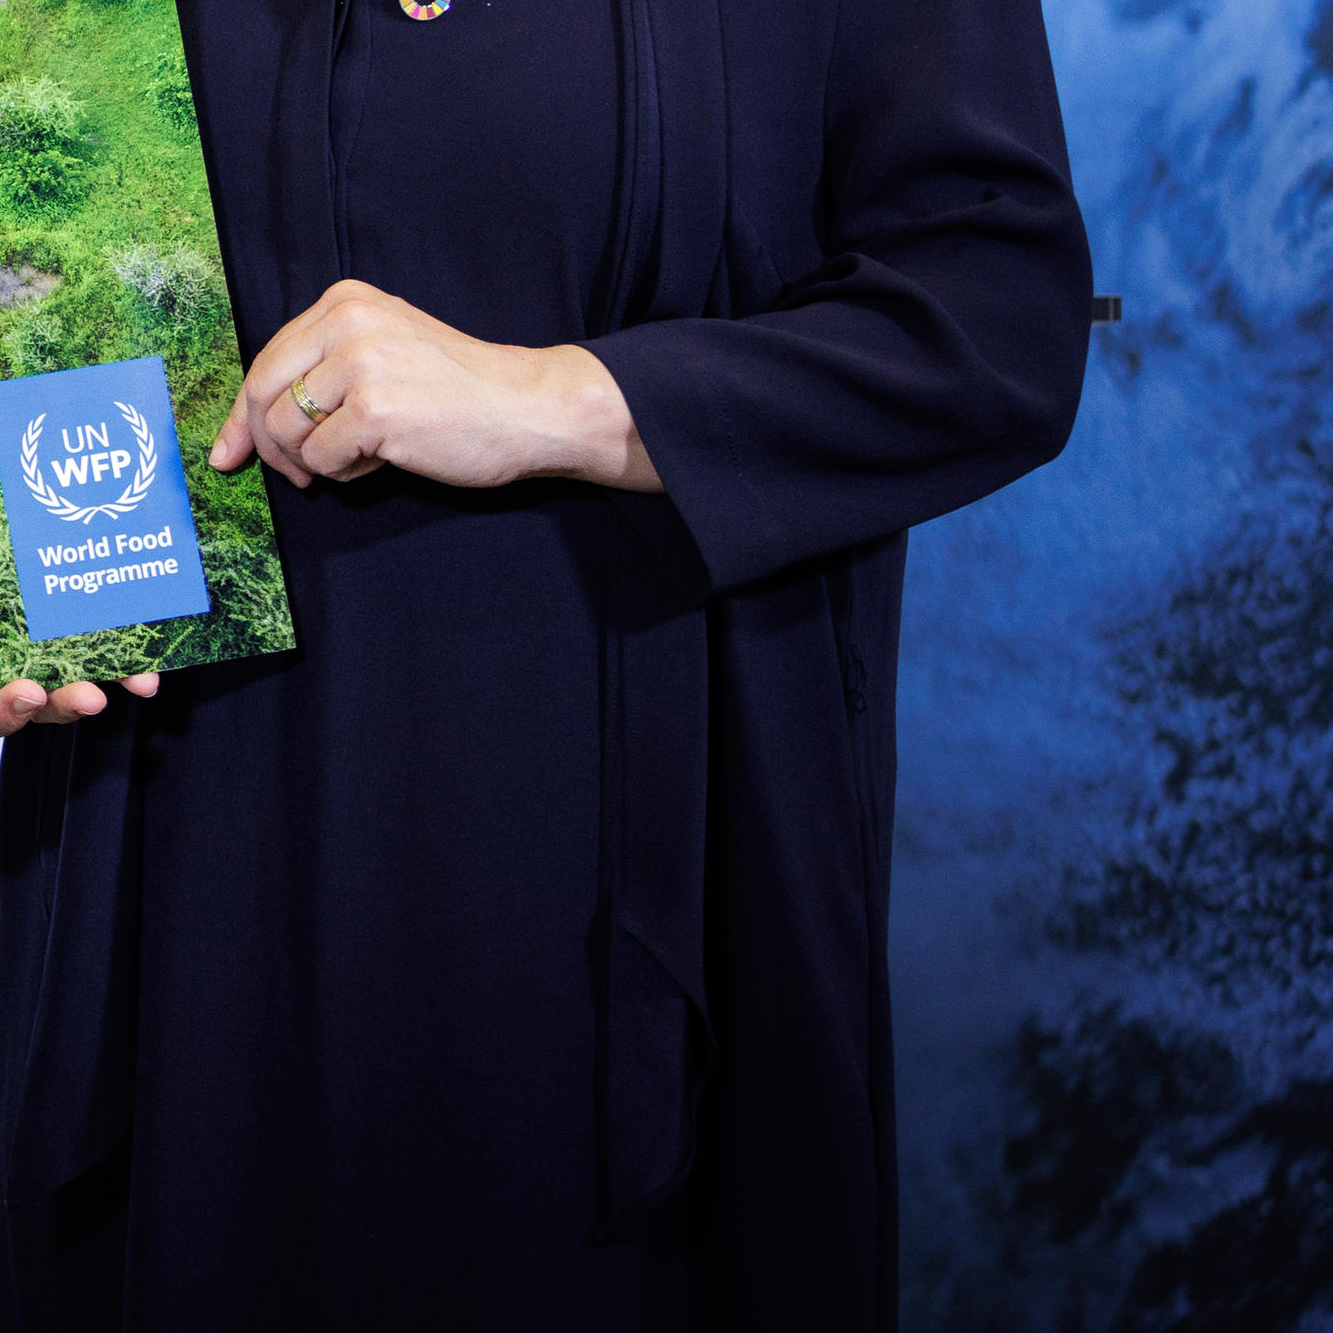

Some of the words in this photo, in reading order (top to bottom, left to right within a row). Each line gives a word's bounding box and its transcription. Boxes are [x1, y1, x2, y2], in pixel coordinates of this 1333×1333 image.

[61, 422, 110, 454] UN
[50, 449, 132, 488] WFP
[37, 536, 111, 567] World
[115, 526, 173, 555] Food
[44, 558, 179, 595] Programme
